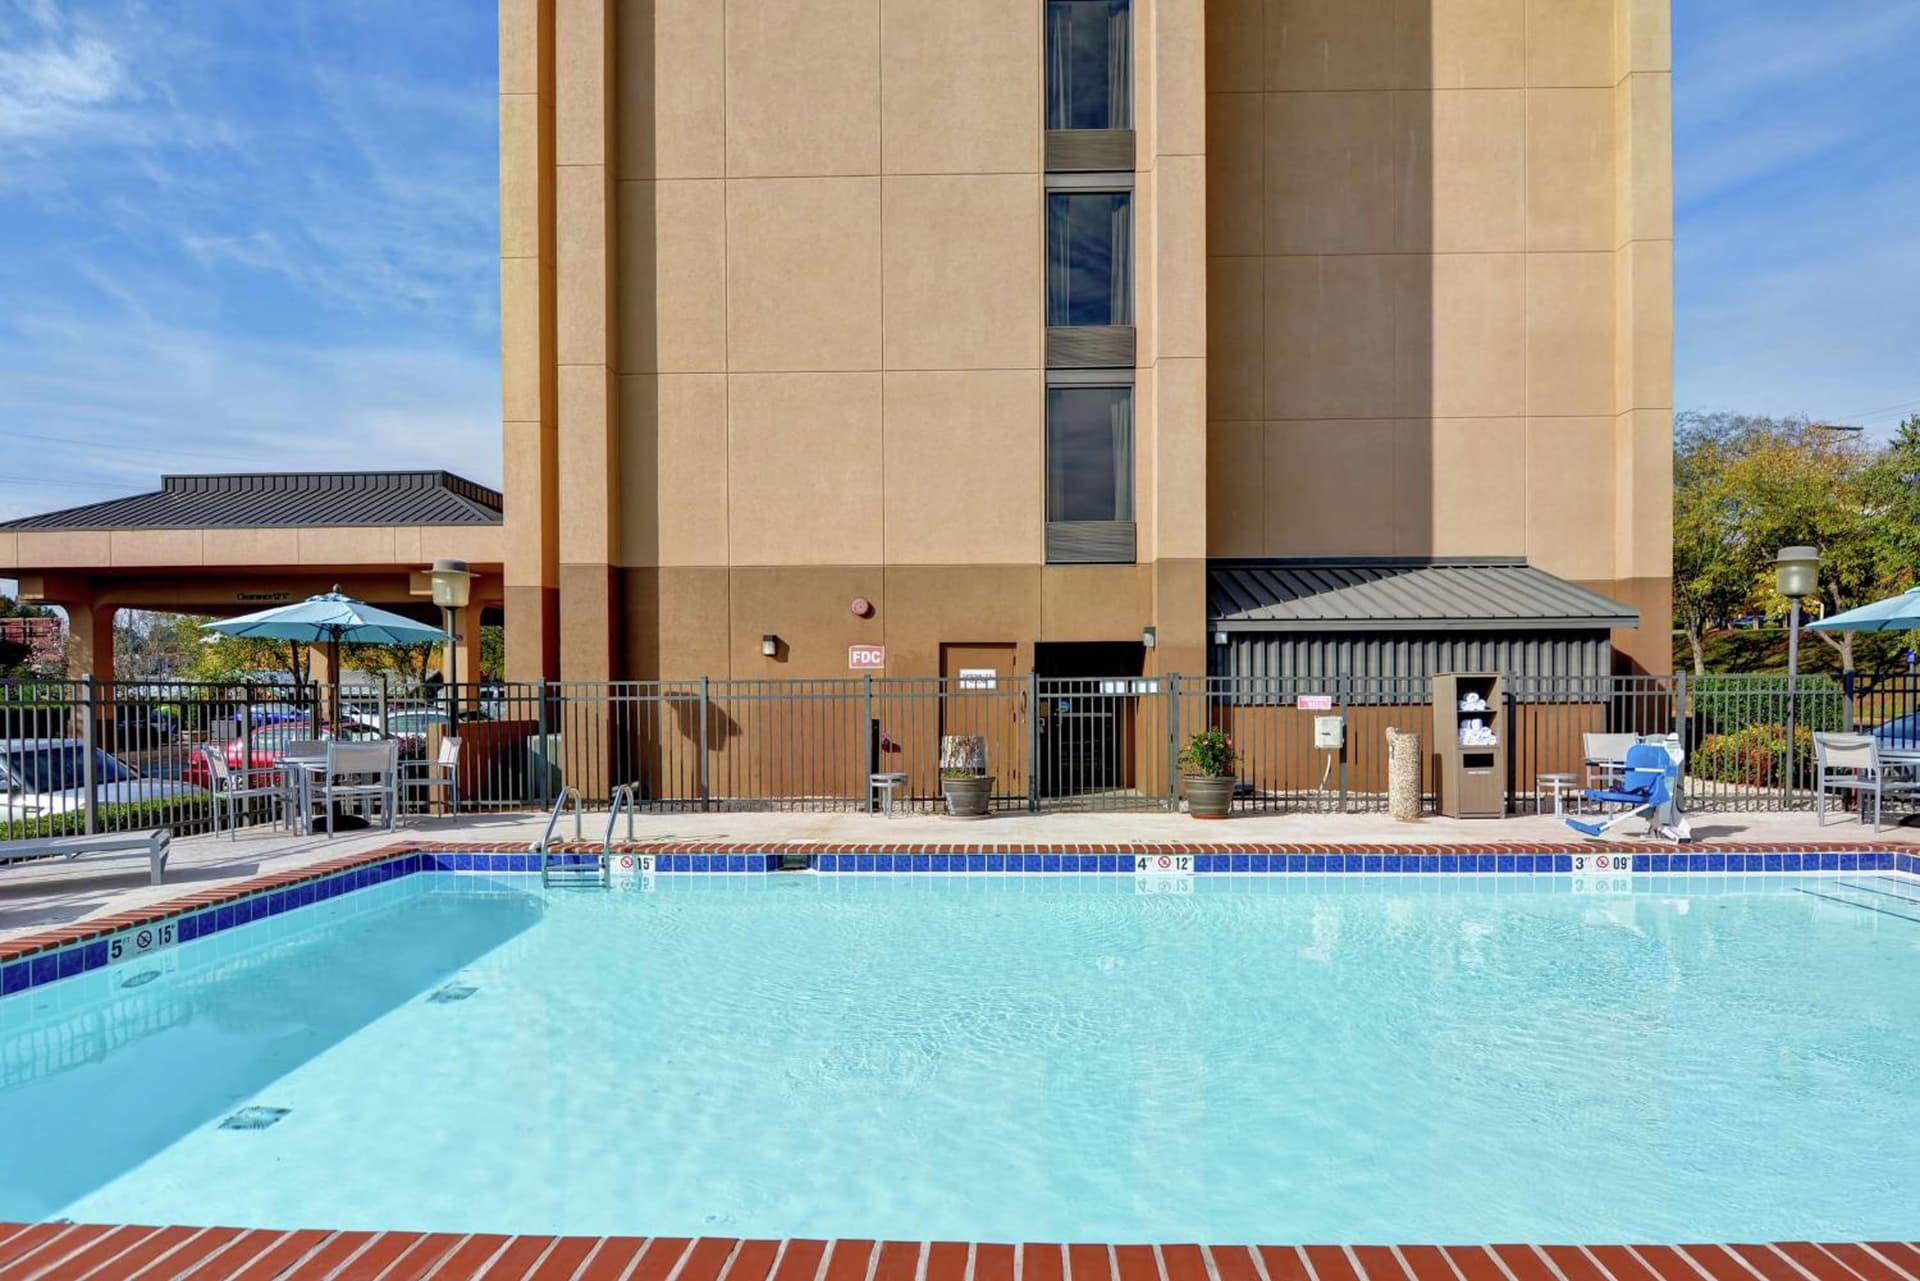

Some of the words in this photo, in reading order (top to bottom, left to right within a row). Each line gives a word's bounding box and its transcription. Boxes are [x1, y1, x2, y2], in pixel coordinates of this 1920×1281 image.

[852, 650, 881, 664] FDC
[1137, 857, 1147, 871] 4
[1176, 857, 1188, 870] 12
[1575, 856, 1584, 870] 3
[1613, 856, 1627, 870] 09
[158, 924, 171, 945] 15
[111, 939, 122, 959] 5
